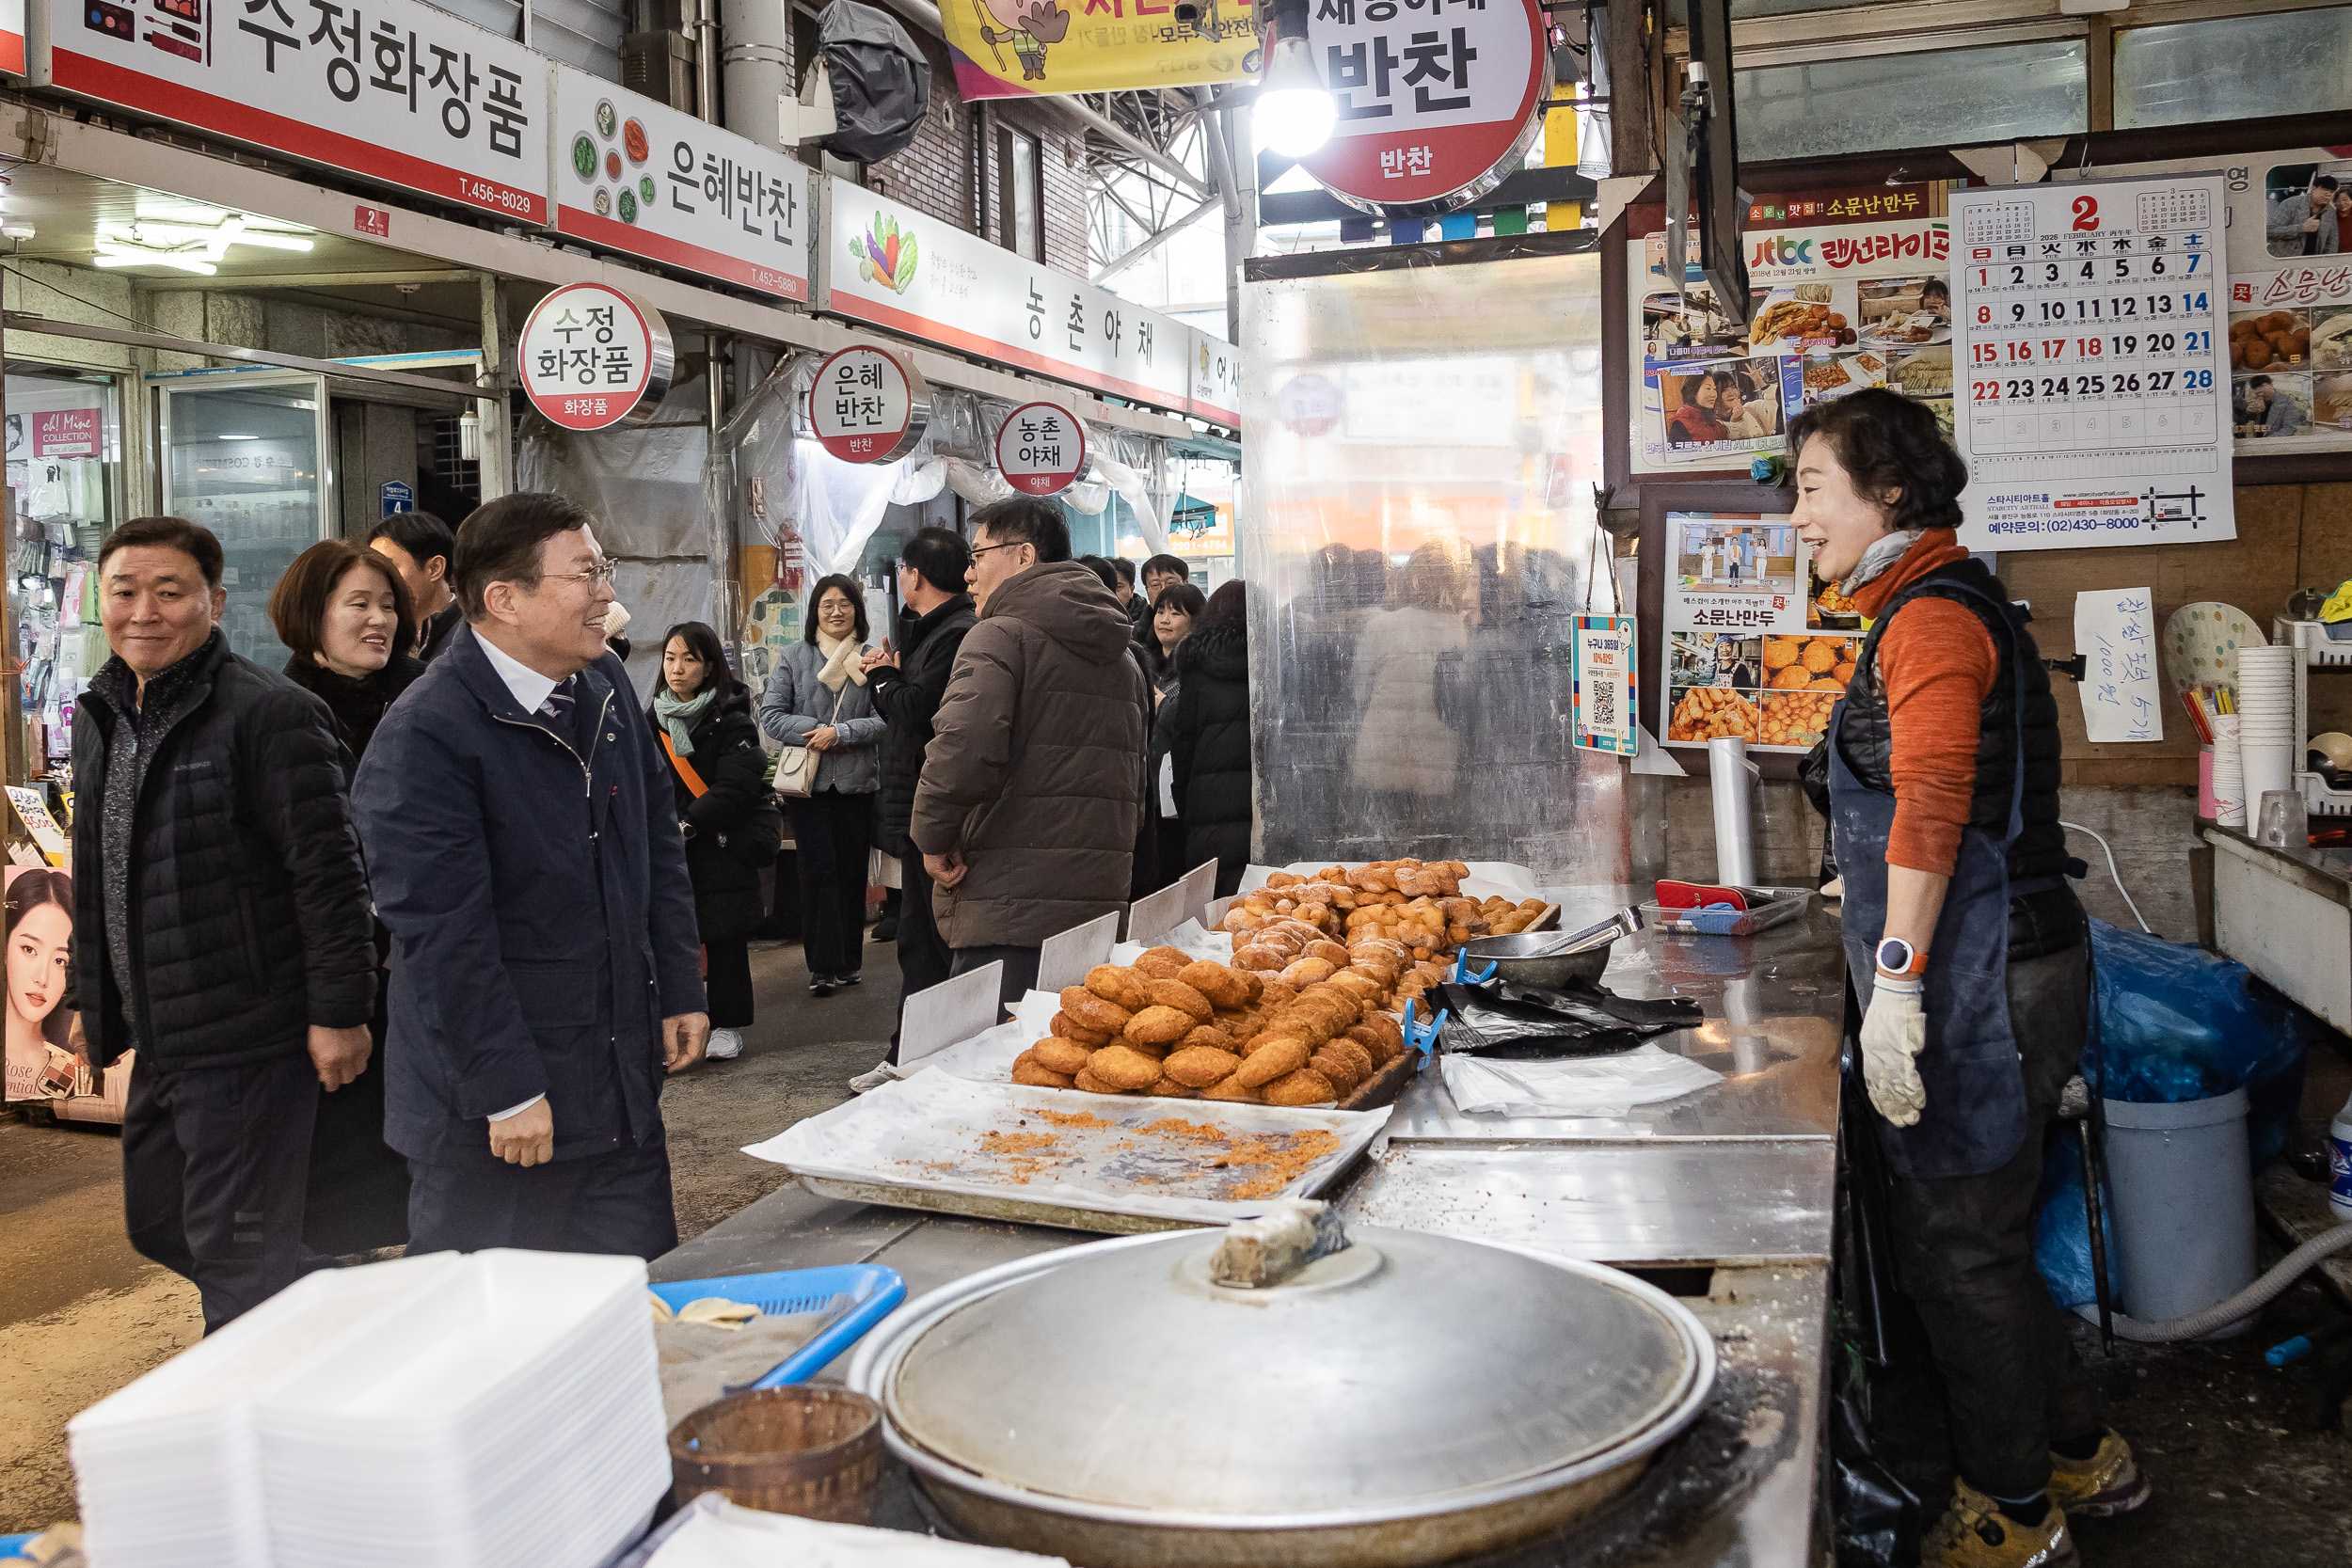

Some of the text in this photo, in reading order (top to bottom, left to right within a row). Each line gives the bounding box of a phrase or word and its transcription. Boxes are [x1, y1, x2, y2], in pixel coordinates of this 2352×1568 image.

[238, 0, 529, 160] 수정화장품
[1327, 26, 1478, 121] 반찬
[1380, 146, 1434, 179] 반찬
[459, 177, 531, 214] T.456-8029
[667, 141, 797, 246] 은혜반찬
[368, 210, 375, 227] 2
[1750, 206, 1786, 220] 소문난
[2072, 196, 2100, 231] 2
[1973, 234, 2203, 259] 日 月 火 水 木 金 土
[2063, 231, 2106, 240] FEBRUARY
[751, 268, 797, 293] T.452-5880
[1750, 266, 1817, 277] 2018년 12월 21일 방영
[1979, 254, 2201, 286] 1 2 3 4 5 6 7
[1978, 293, 2208, 324] 8 9 10 11 12 13 14
[553, 305, 614, 344] 수정
[1973, 331, 2209, 362] 15 16 17 18 19 20 21
[537, 346, 633, 385] 화장품
[834, 363, 882, 395] 은혜
[1972, 381, 2000, 400] 22
[2007, 379, 2034, 398] 23
[2041, 377, 2070, 396] 24
[2076, 375, 2105, 394] 25
[2112, 373, 2139, 392] 26
[2147, 372, 2175, 390] 27
[2183, 370, 2212, 388] 28
[564, 398, 609, 416] 화장품
[835, 395, 885, 427] 반찬
[63, 413, 91, 430] Mine
[1019, 417, 1060, 442] 농촌
[42, 432, 92, 443] COLLECTION
[850, 437, 873, 453] 반찬
[1733, 437, 1754, 450] ALL
[1756, 436, 1785, 449] CLEA
[1019, 445, 1060, 467] 야채
[1030, 476, 1051, 488] 야채
[1987, 493, 2050, 504] 스타시티아트홀
[1693, 609, 1775, 627] 소문난만두
[1587, 638, 1618, 650] 누구나 365일
